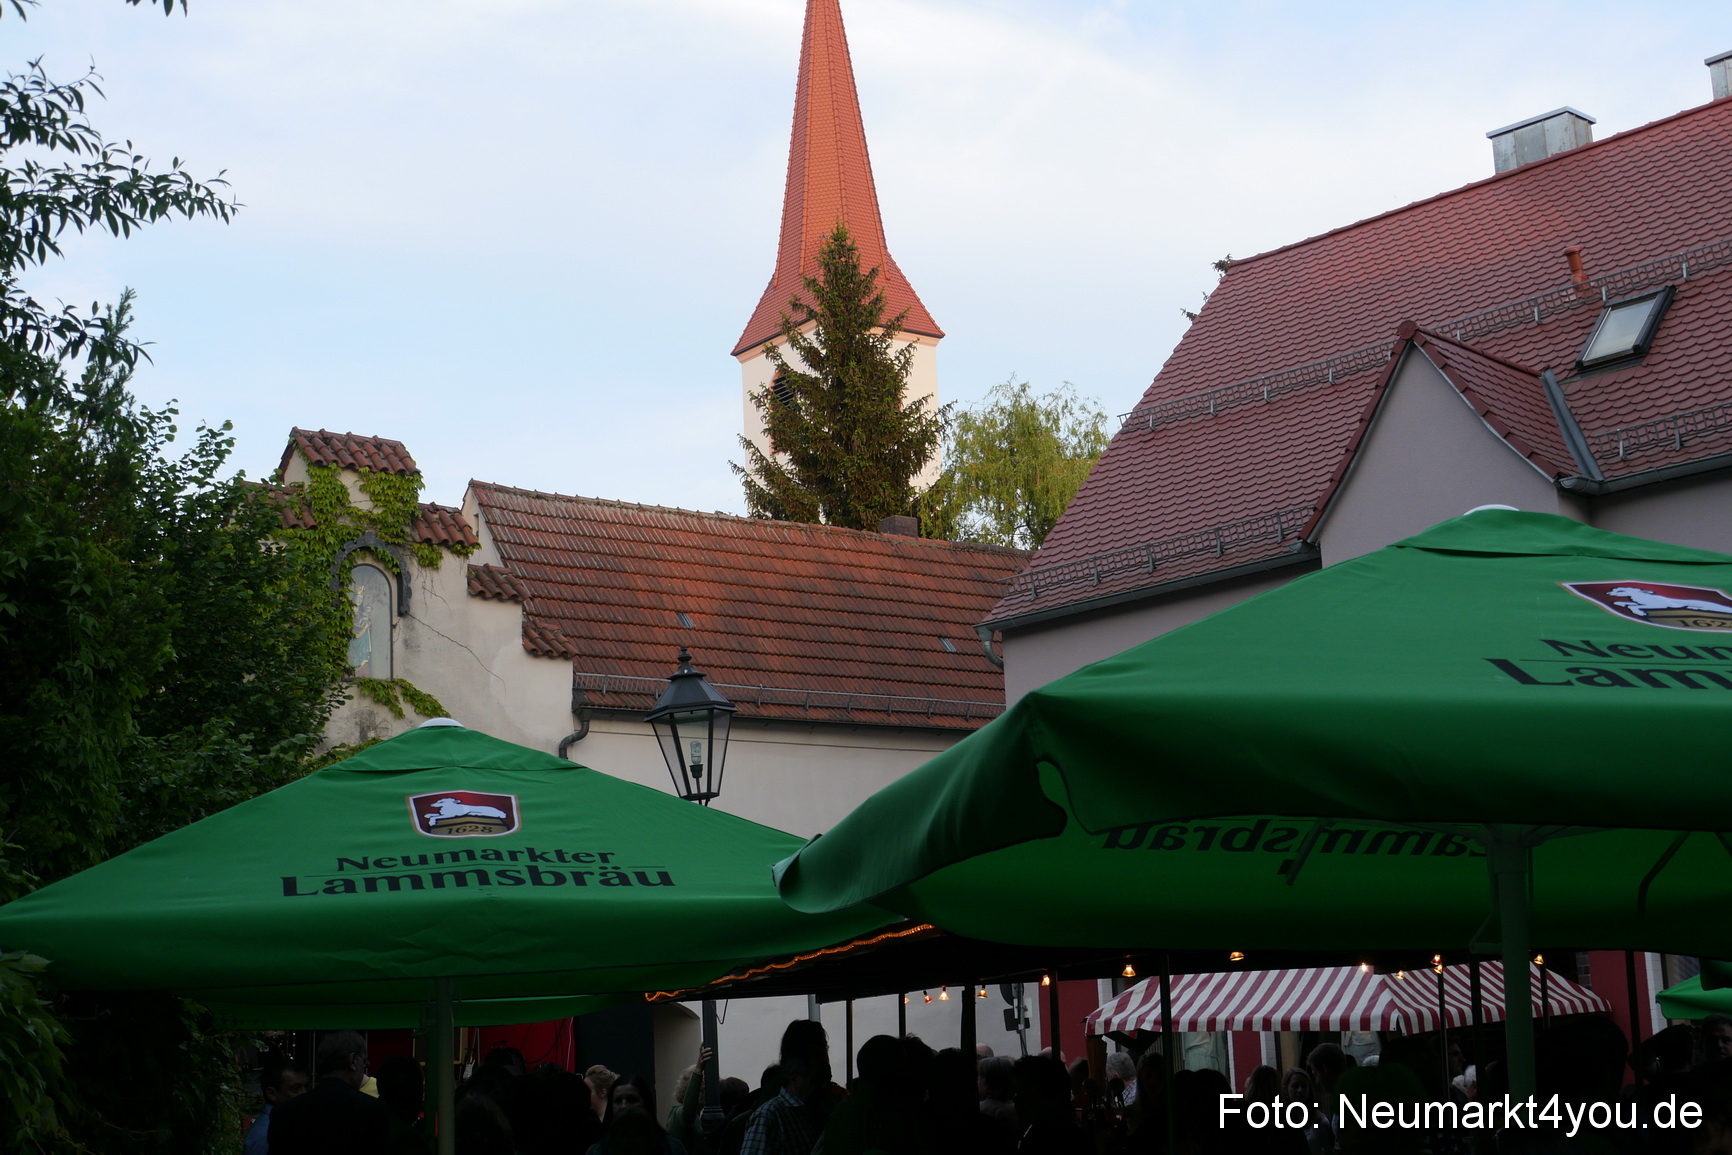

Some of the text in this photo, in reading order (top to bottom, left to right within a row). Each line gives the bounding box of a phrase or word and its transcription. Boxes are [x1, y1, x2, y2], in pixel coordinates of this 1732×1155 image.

[1675, 619, 1732, 628] 162
[1482, 658, 1732, 690] Lam
[447, 825, 493, 835] 1628
[335, 846, 616, 872] Neumarkter
[280, 865, 677, 897] Lammsbräu
